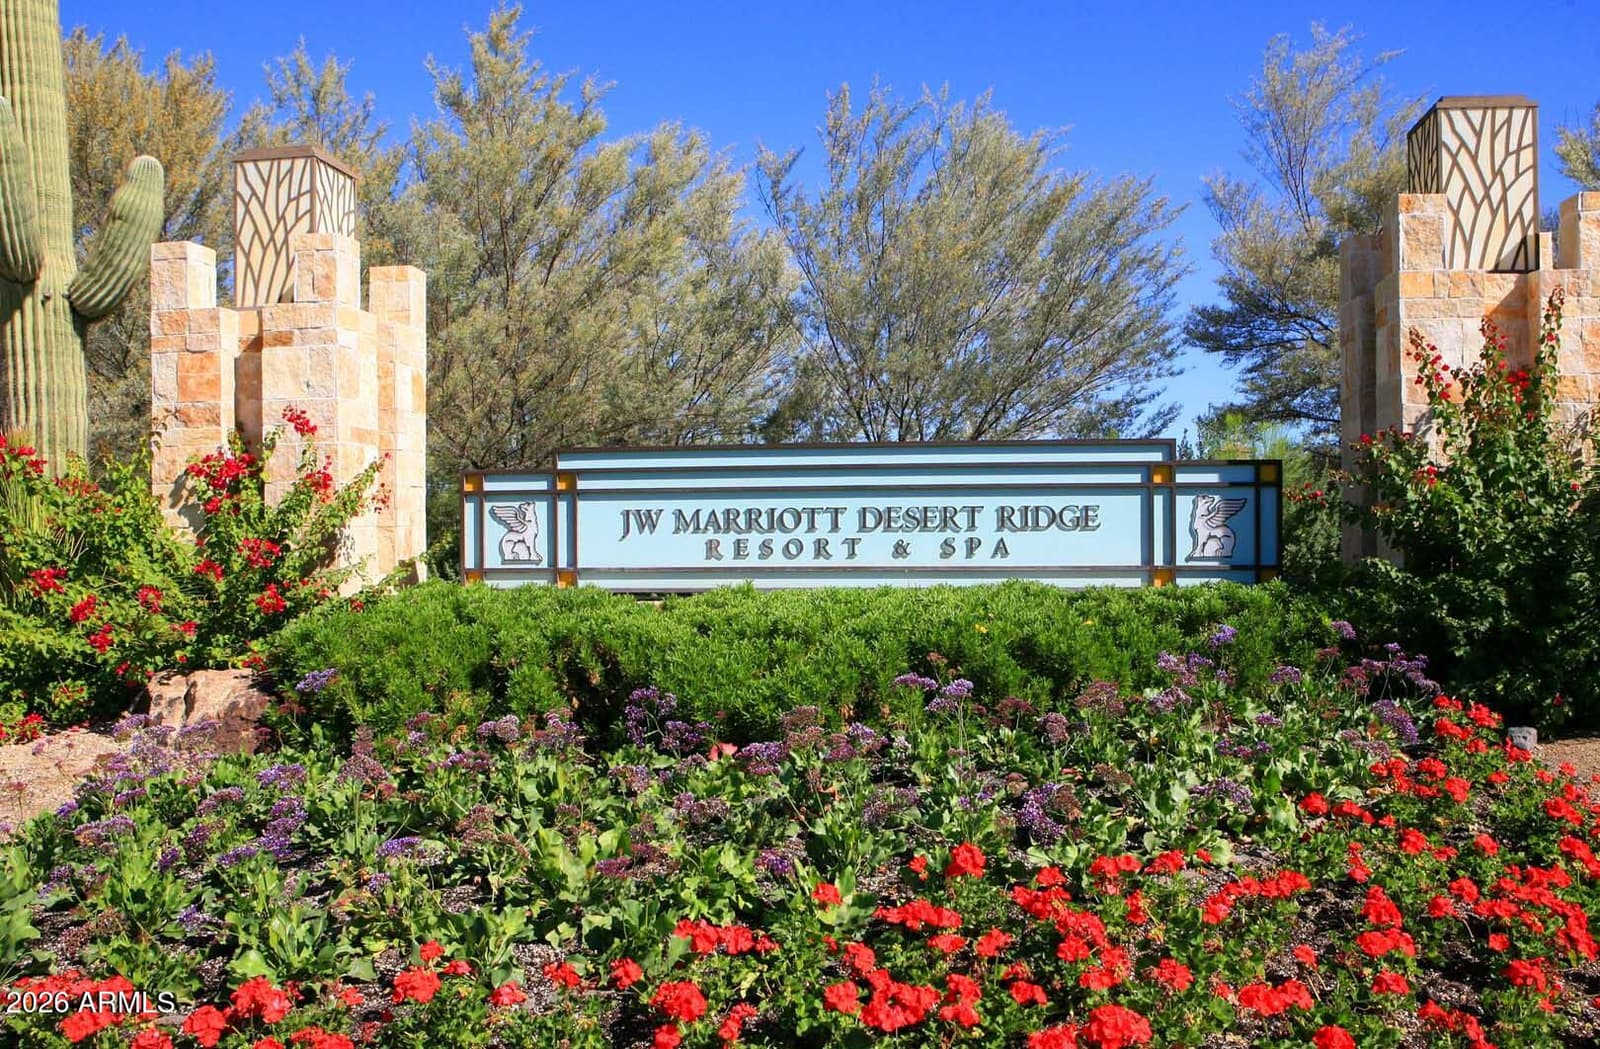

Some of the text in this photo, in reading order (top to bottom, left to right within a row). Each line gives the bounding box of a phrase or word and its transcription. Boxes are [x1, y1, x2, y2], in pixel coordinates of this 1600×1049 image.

[619, 504, 1101, 542] JW MARRIOTT DESERT RIDGE
[704, 536, 1011, 561] RESORT & SPA
